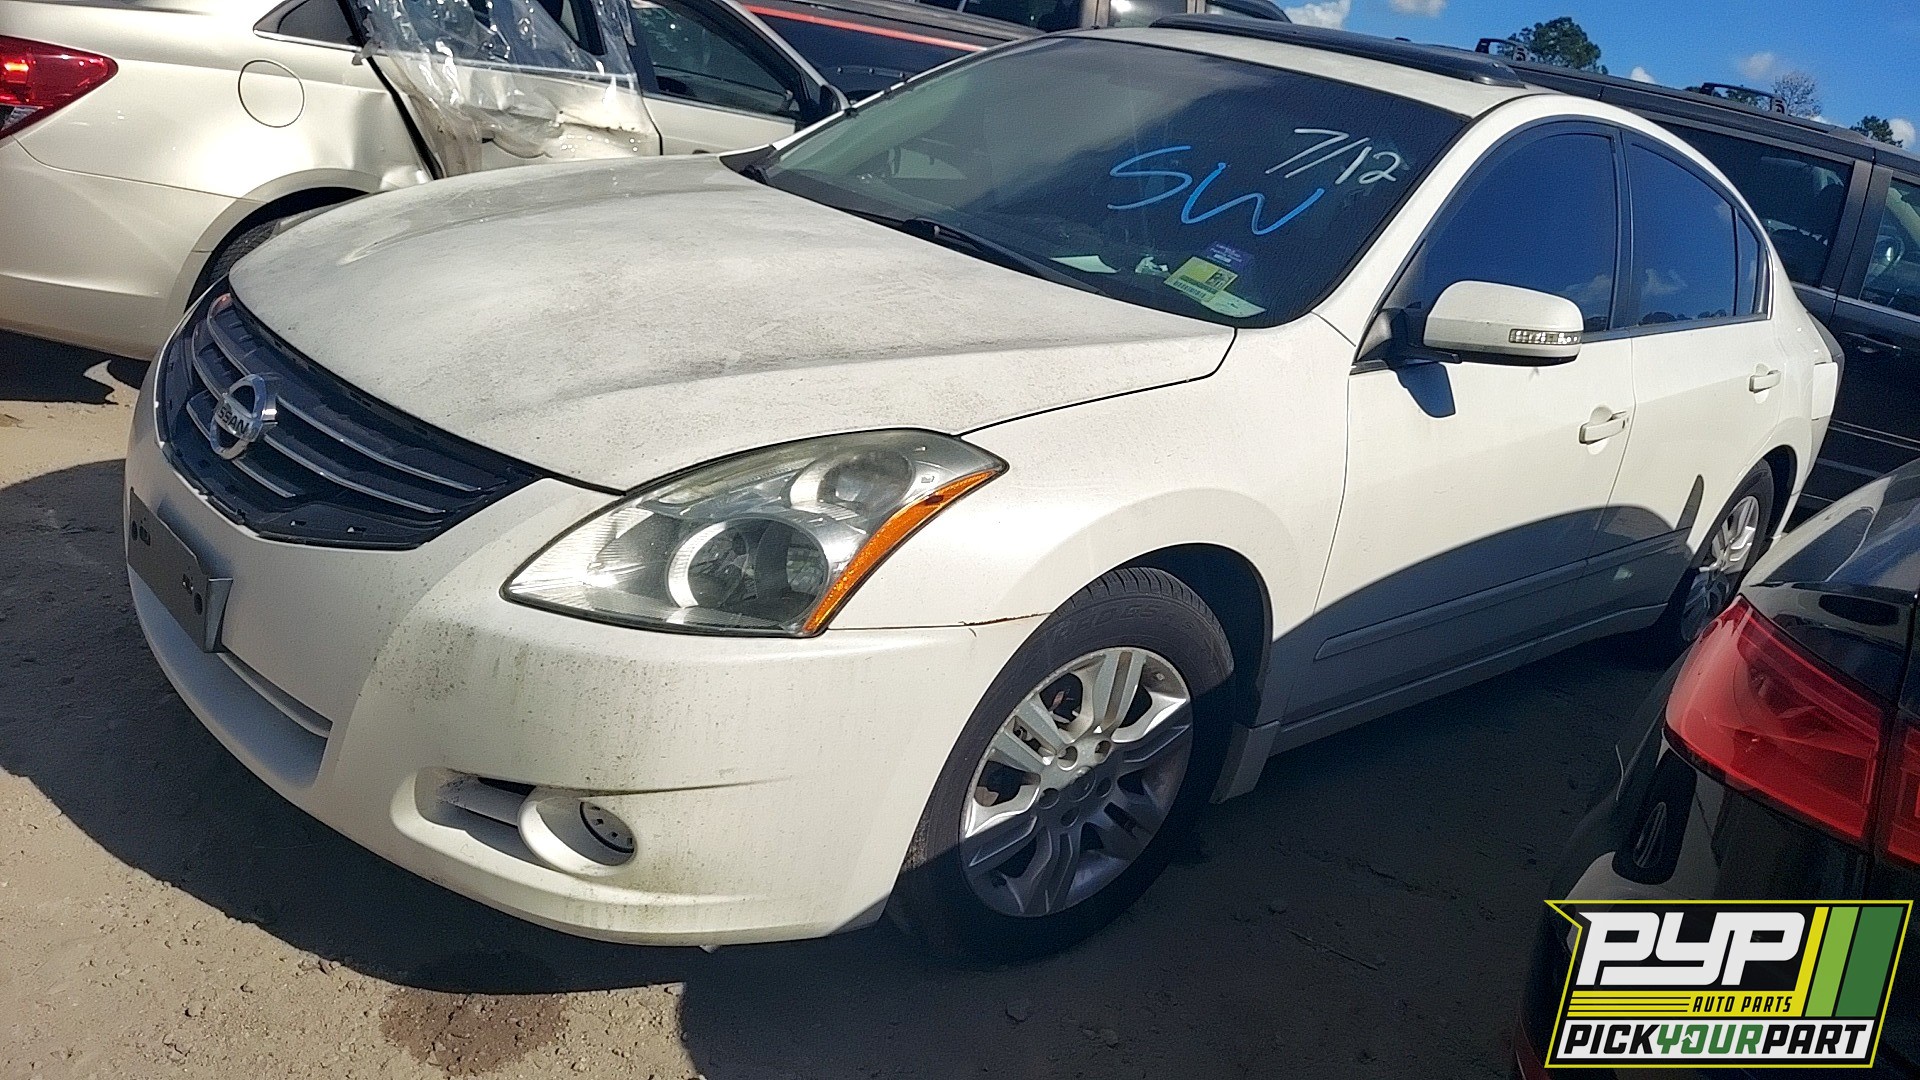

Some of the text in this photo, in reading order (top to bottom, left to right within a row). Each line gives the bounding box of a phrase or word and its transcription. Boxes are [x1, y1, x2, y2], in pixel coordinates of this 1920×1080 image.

[1265, 128, 1401, 185] 7/12
[1107, 145, 1325, 235] SW
[217, 406, 250, 434] SSAN
